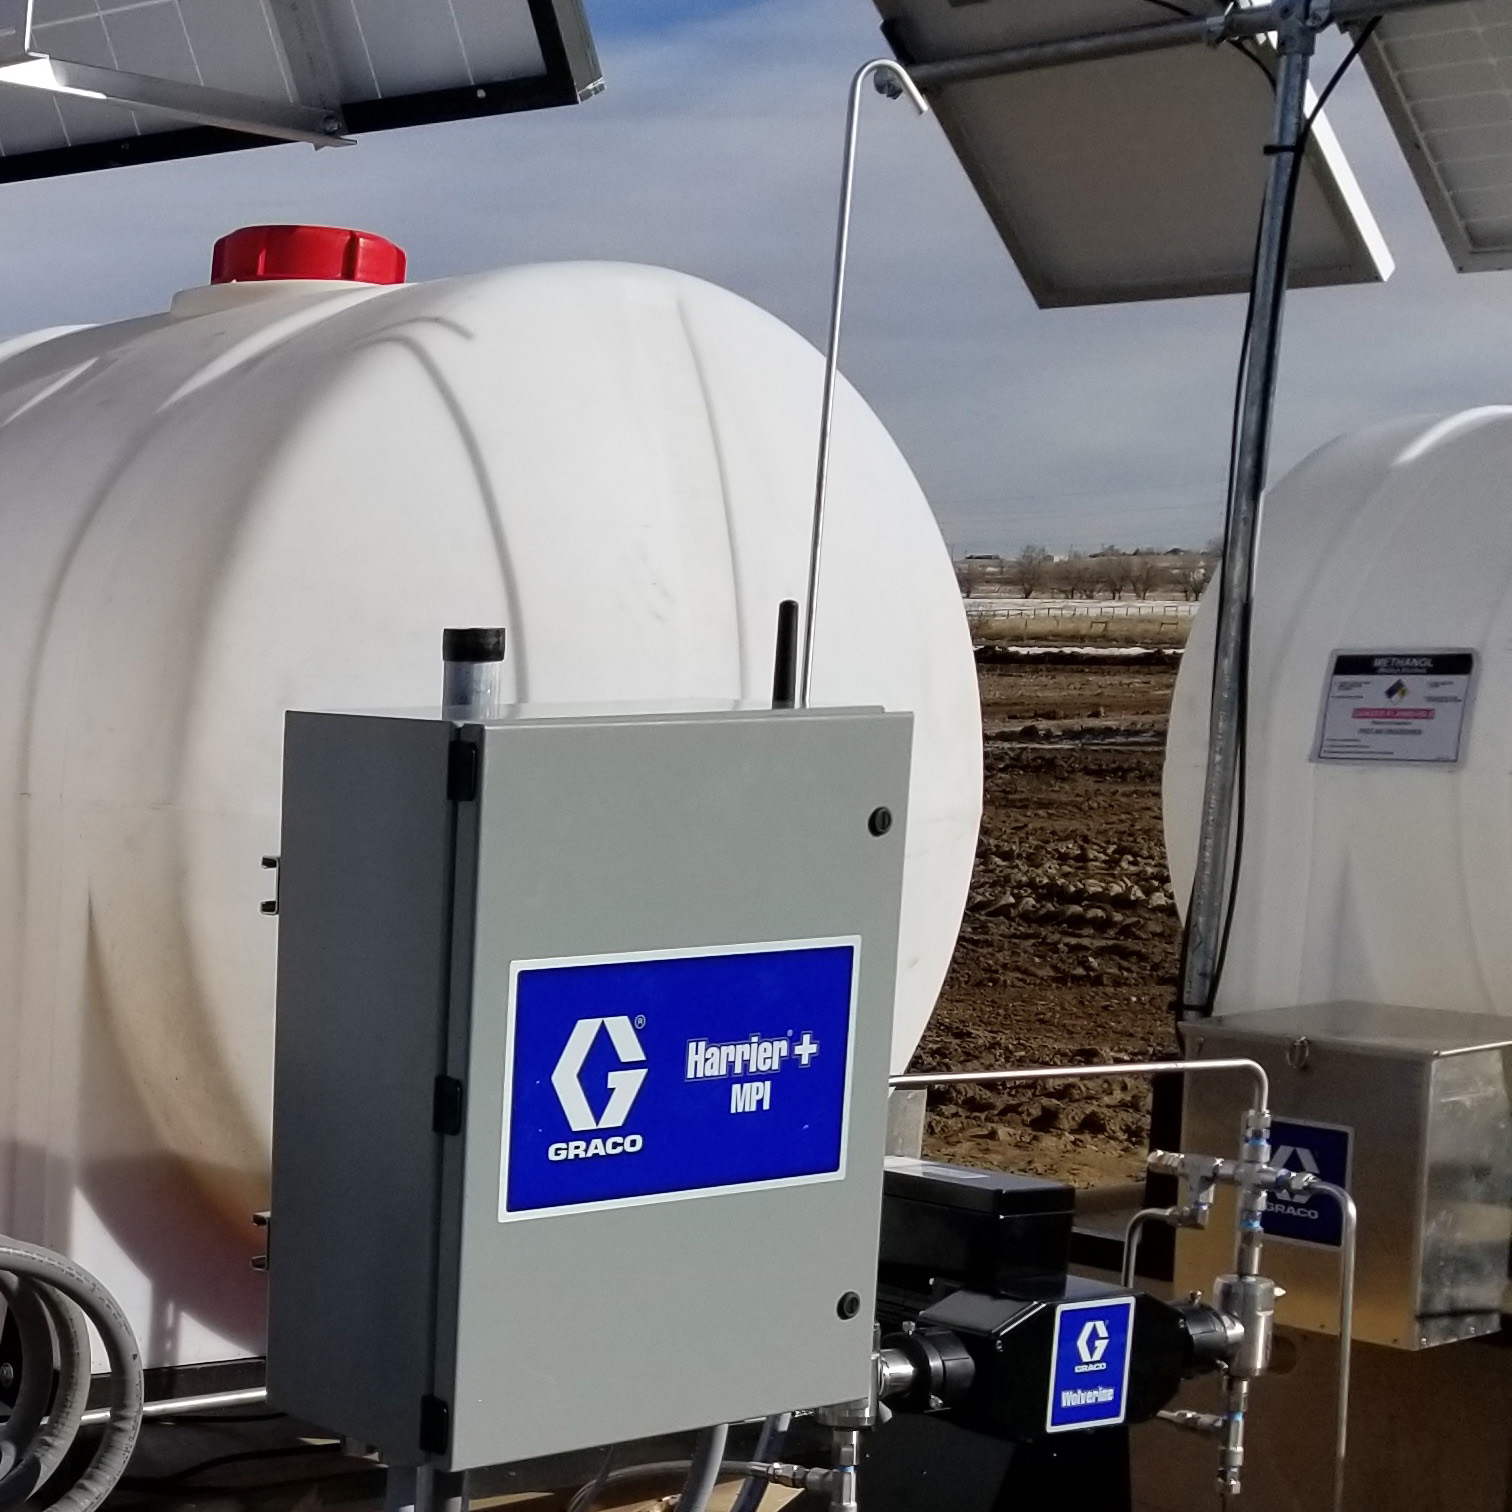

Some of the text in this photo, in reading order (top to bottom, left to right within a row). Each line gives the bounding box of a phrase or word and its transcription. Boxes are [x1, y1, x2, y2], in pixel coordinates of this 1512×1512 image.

[730, 1080, 772, 1114] MPI
[547, 1134, 644, 1161] GRACO
[1061, 1387, 1115, 1408] Wolverine
